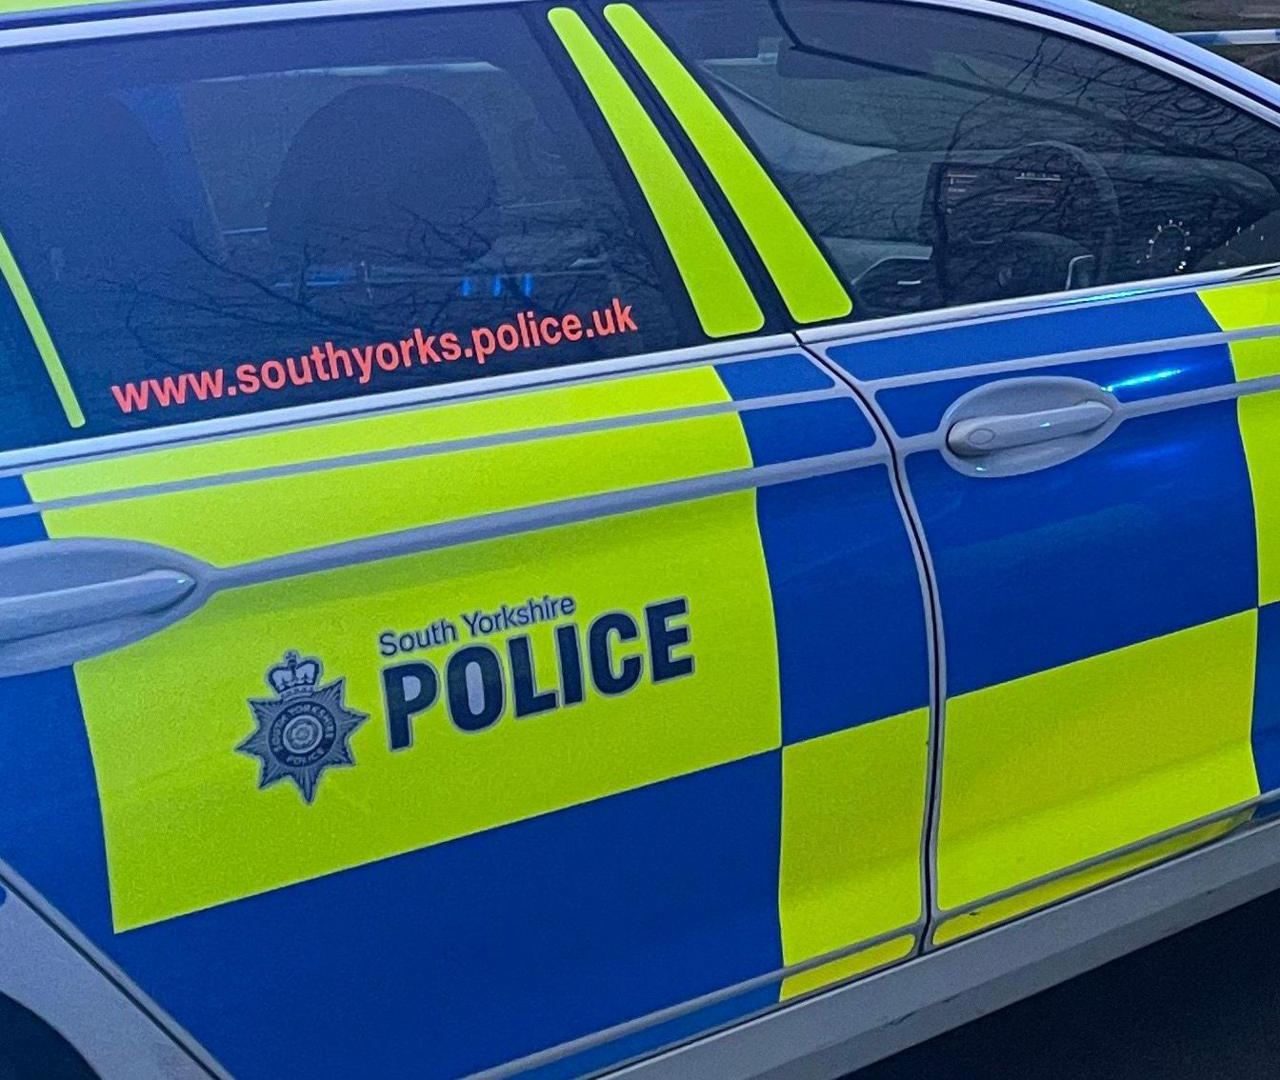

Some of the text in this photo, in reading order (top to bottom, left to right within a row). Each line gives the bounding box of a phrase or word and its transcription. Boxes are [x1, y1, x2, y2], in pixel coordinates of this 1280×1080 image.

[111, 298, 638, 414] www.southyorks.police.uk
[379, 595, 577, 657] South Yorkshire
[381, 597, 696, 752] POLICE
